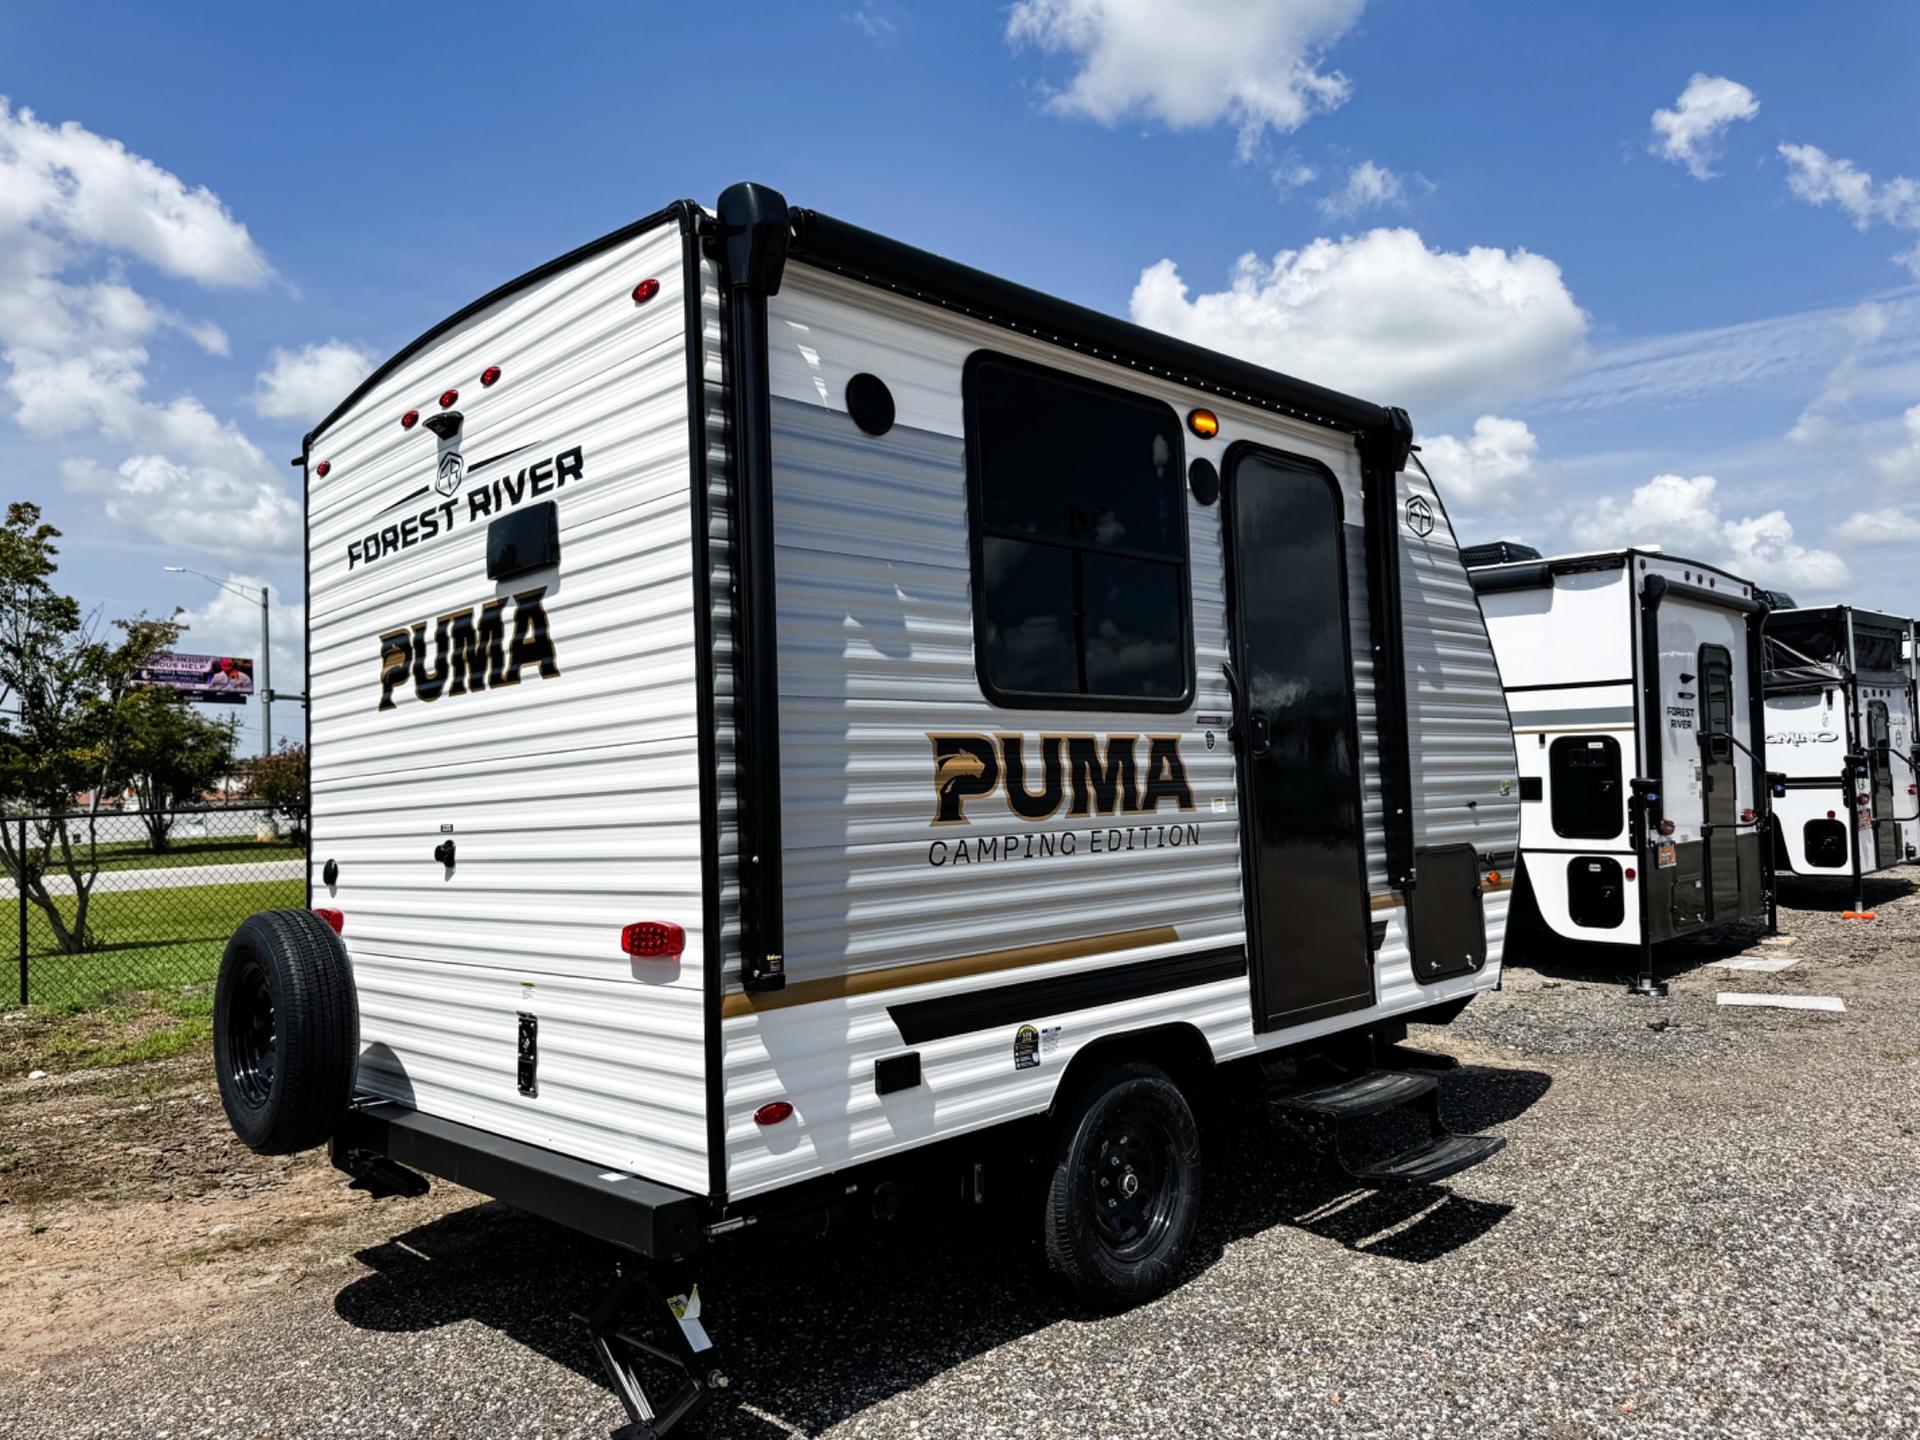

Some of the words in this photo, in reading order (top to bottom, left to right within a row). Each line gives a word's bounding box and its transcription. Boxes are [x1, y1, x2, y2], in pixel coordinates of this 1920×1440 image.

[347, 498, 459, 571] FOREST
[468, 445, 584, 522] RIVER
[378, 586, 561, 712] PUMA
[1666, 706, 1695, 717] FOREST
[1670, 719, 1693, 729] RIVER
[926, 732, 1198, 827] PUMA
[928, 832, 1077, 867] CAMPING
[1090, 823, 1201, 853] EDITION
